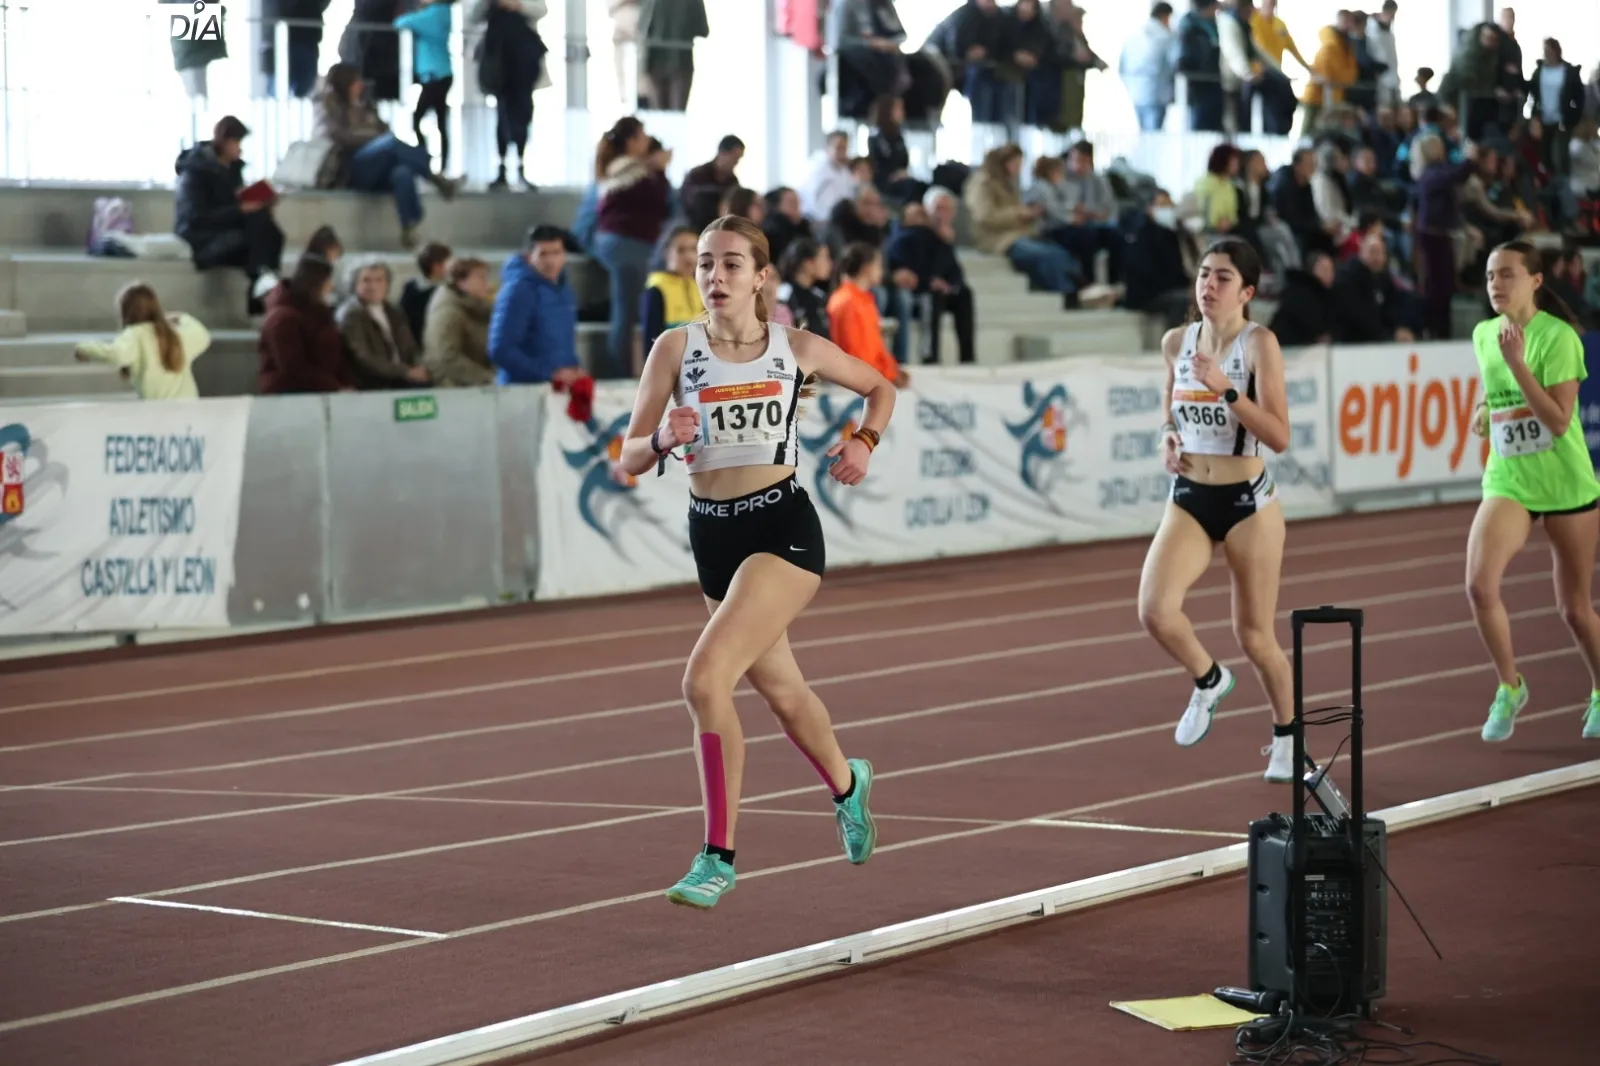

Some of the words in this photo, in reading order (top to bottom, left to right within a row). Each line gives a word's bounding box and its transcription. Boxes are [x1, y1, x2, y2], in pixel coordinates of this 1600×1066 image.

[710, 400, 782, 431] 1370
[1178, 405, 1226, 426] 1366
[1503, 420, 1541, 444] 319
[105, 424, 205, 475] FEDERACIÓN
[109, 497, 195, 536] ATLETISMO
[691, 498, 729, 517] NIKE
[734, 489, 782, 516] PRO
[81, 557, 157, 597] CASTILLA
[160, 558, 172, 592] Y
[173, 547, 216, 595] LEÓN
